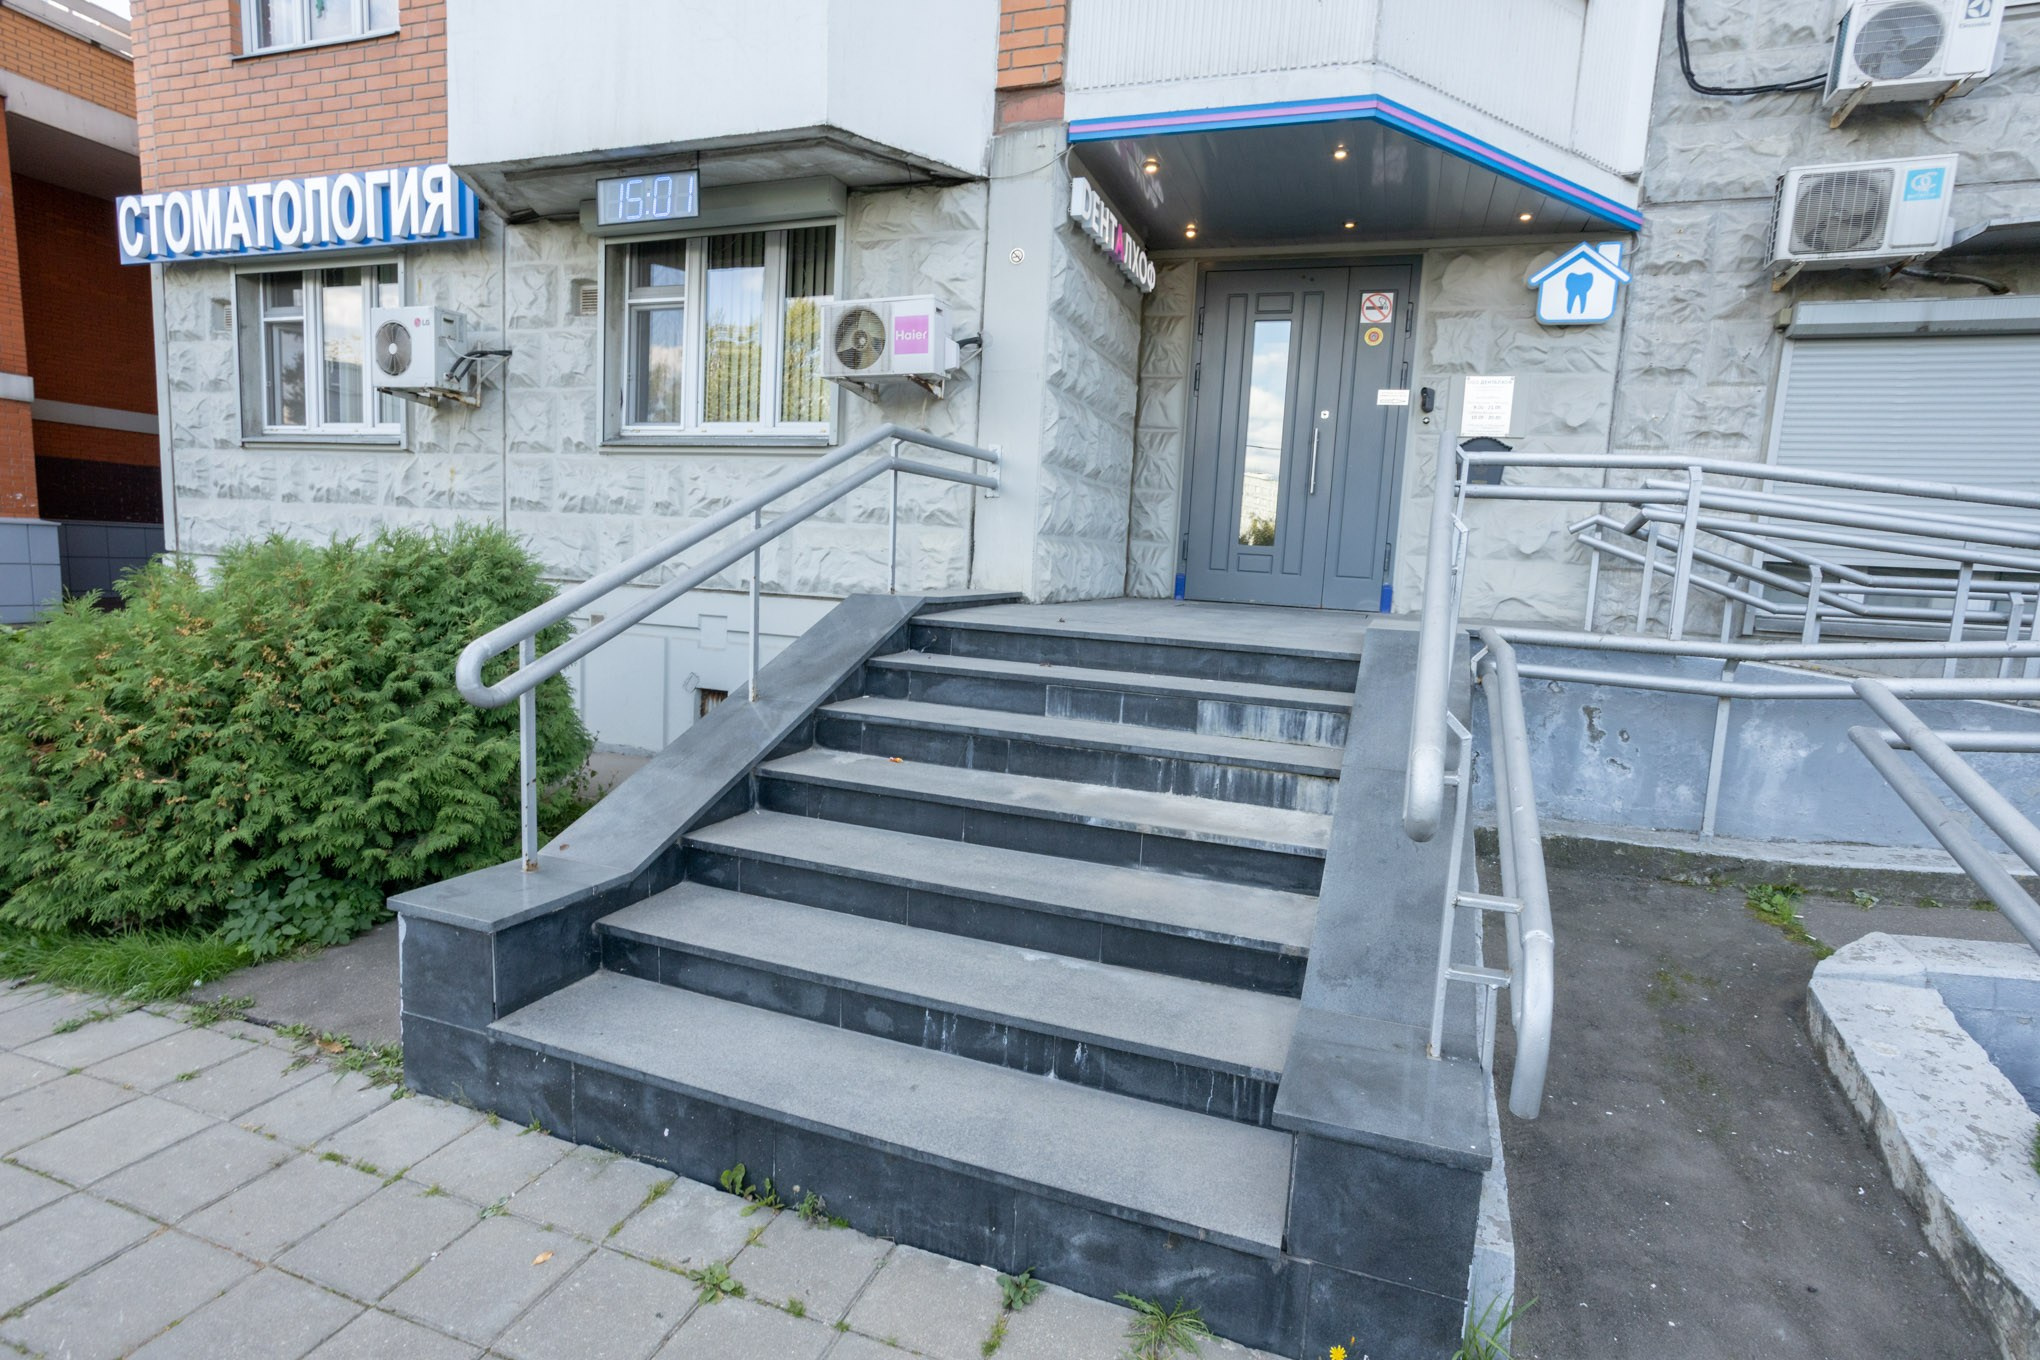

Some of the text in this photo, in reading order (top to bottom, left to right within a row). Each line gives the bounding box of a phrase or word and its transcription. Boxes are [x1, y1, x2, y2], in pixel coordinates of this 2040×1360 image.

[119, 165, 452, 257] СТОМАТОЛОГИЯ
[618, 176, 694, 219] 15:01
[895, 330, 928, 341] Haier
